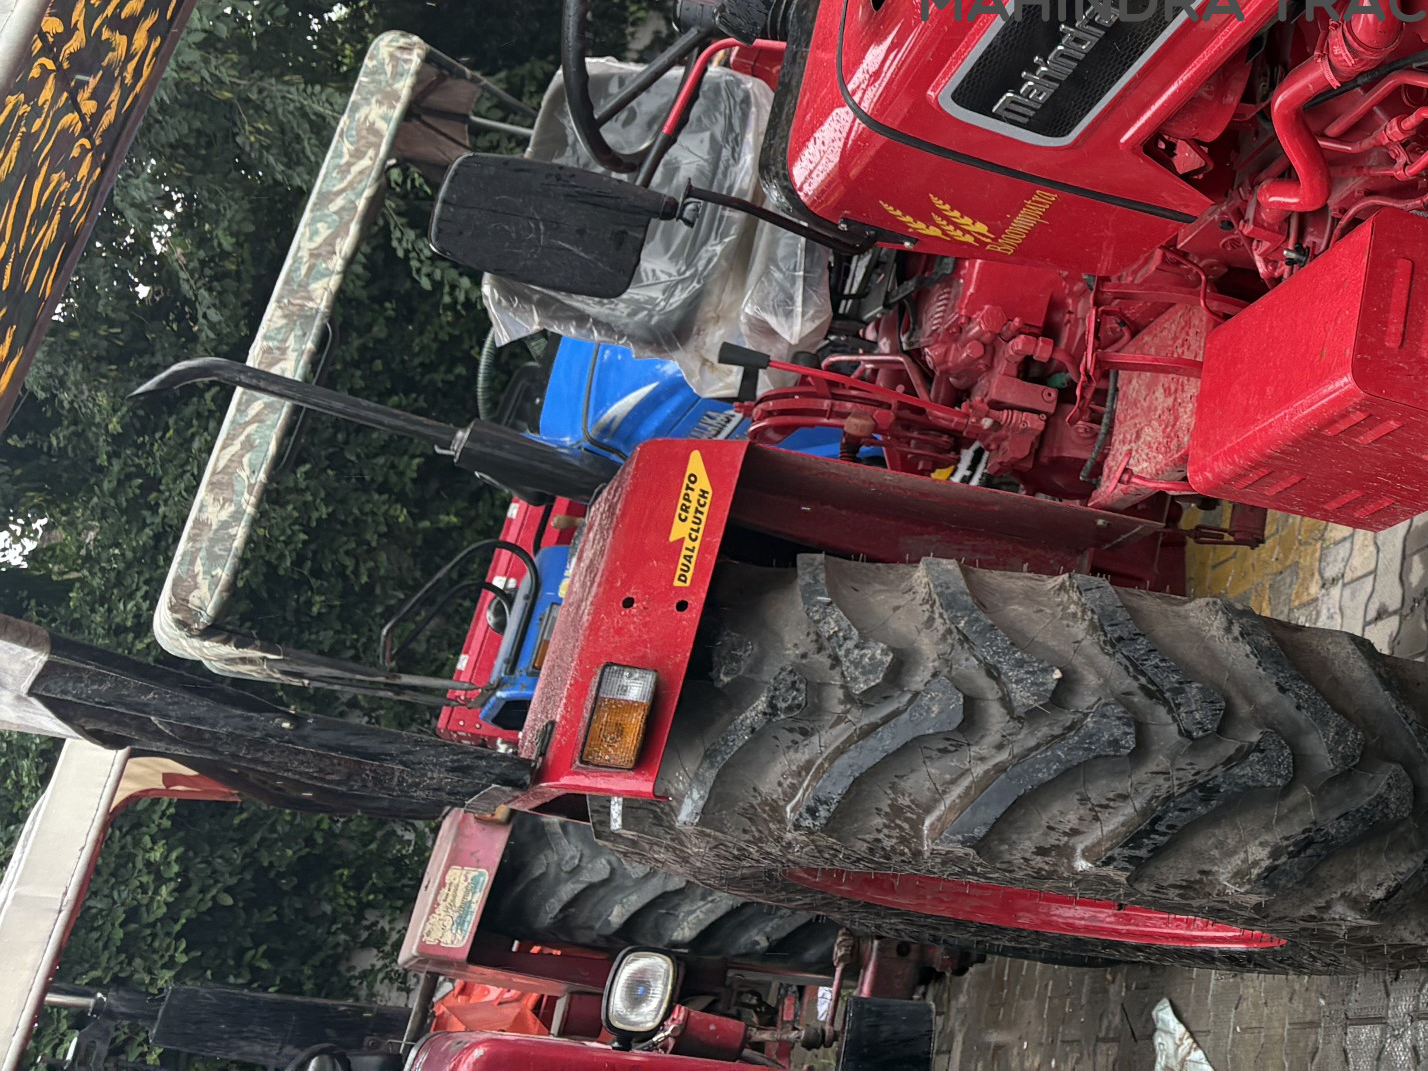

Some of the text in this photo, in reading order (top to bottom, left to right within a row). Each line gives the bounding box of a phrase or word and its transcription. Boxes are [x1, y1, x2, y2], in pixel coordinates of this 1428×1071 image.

[678, 471, 698, 522] CRPTO
[677, 487, 710, 583] DUAL CLUTCH
